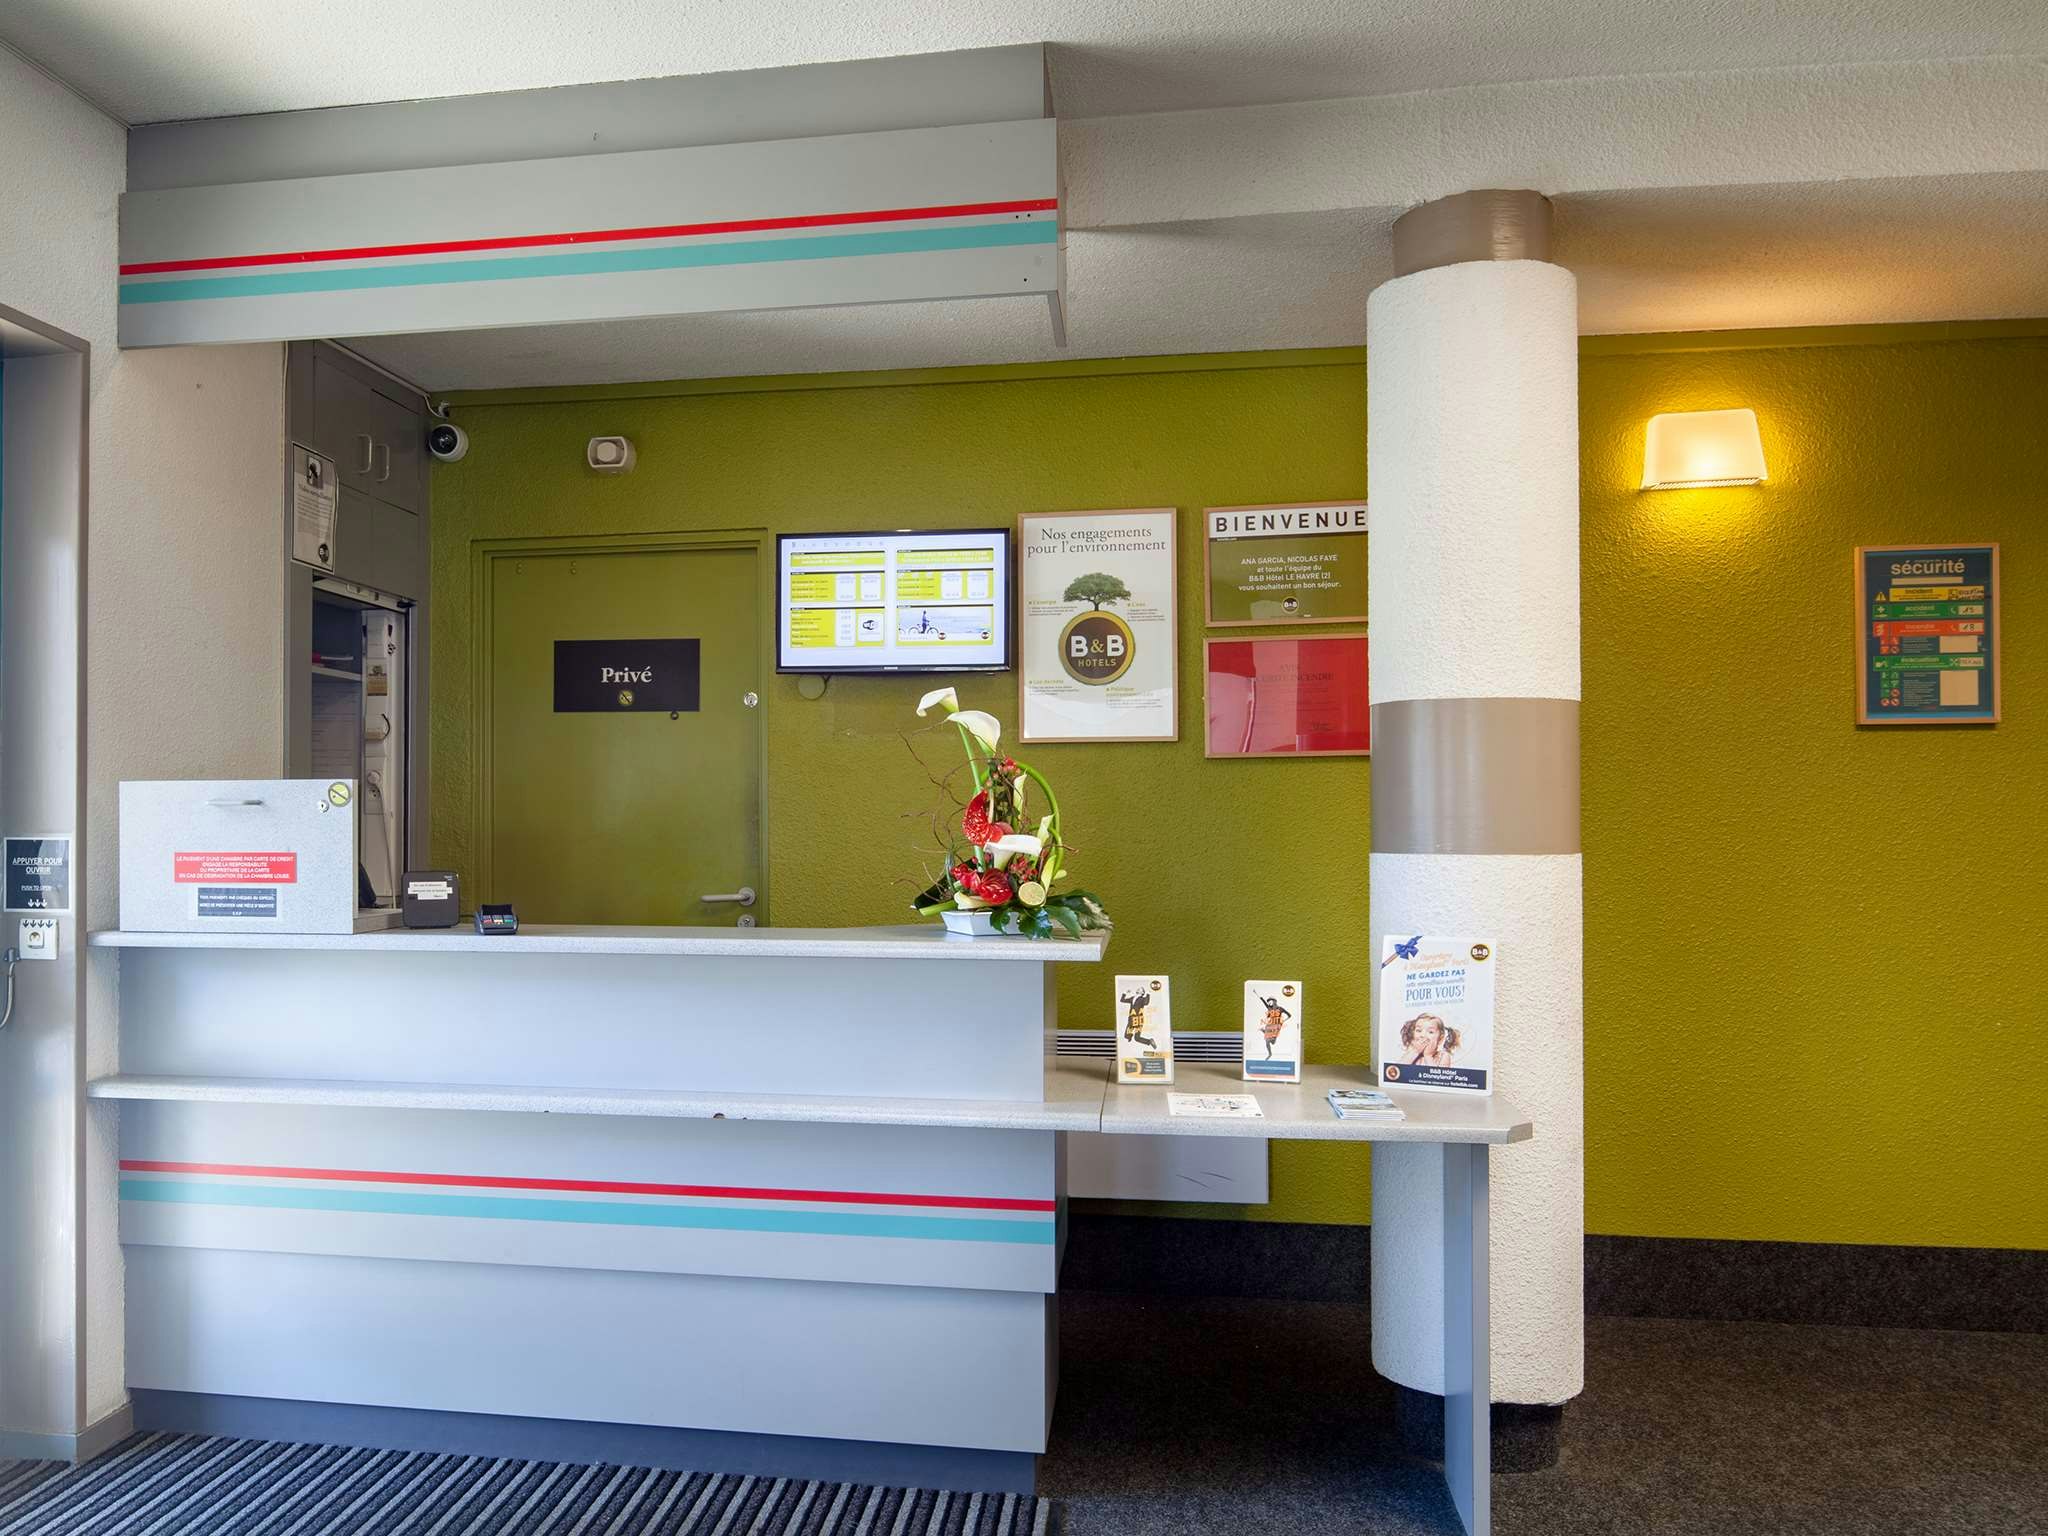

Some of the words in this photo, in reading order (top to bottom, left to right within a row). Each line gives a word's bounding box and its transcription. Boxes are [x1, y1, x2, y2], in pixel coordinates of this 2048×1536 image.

[1216, 511, 1366, 532] BIENVENUE
[1041, 528, 1066, 540] Nos
[1070, 527, 1152, 542] engagements
[1027, 543, 1058, 558] pour
[1061, 540, 1166, 554] l'environnement
[1287, 555, 1318, 563] NICOLAS
[1891, 558, 1965, 575] sécurité
[1071, 634, 1125, 657] B&B
[1078, 658, 1117, 668] HOTELS
[600, 665, 653, 684] Privé
[1406, 973, 1417, 981] NE
[1418, 970, 1450, 980] GARDEZ
[1451, 968, 1466, 976] PAS
[1406, 987, 1432, 1001] POUR
